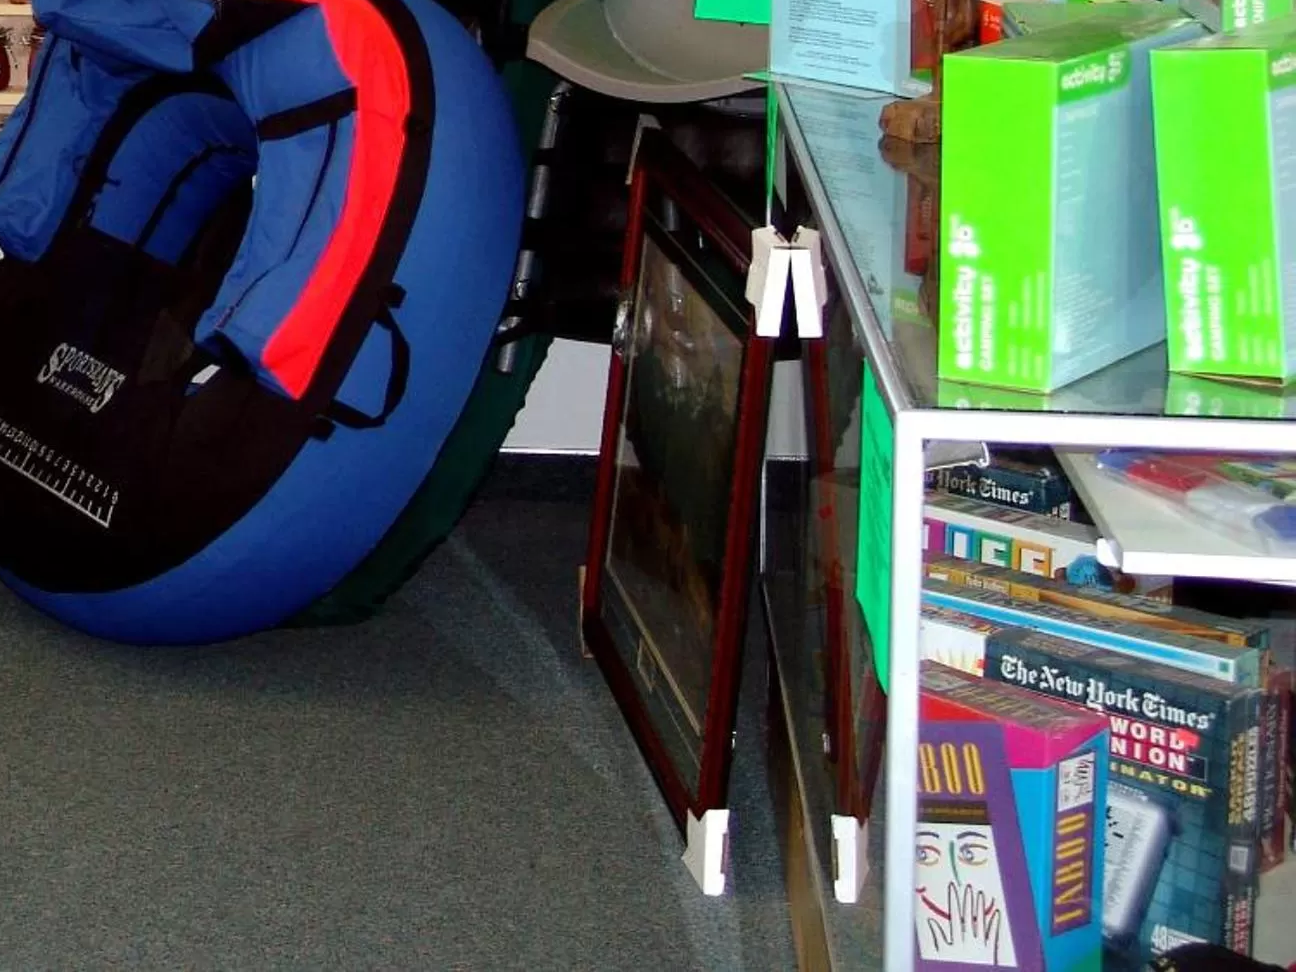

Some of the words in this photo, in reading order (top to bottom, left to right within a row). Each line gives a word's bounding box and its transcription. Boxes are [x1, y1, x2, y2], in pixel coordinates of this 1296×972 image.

[980, 477, 1029, 505] Times
[1000, 654, 1038, 685] The
[1039, 666, 1084, 696] New
[1086, 678, 1140, 711] York
[1142, 692, 1210, 729] Times
[918, 742, 986, 796] BOO
[1055, 812, 1088, 924] TABOO
